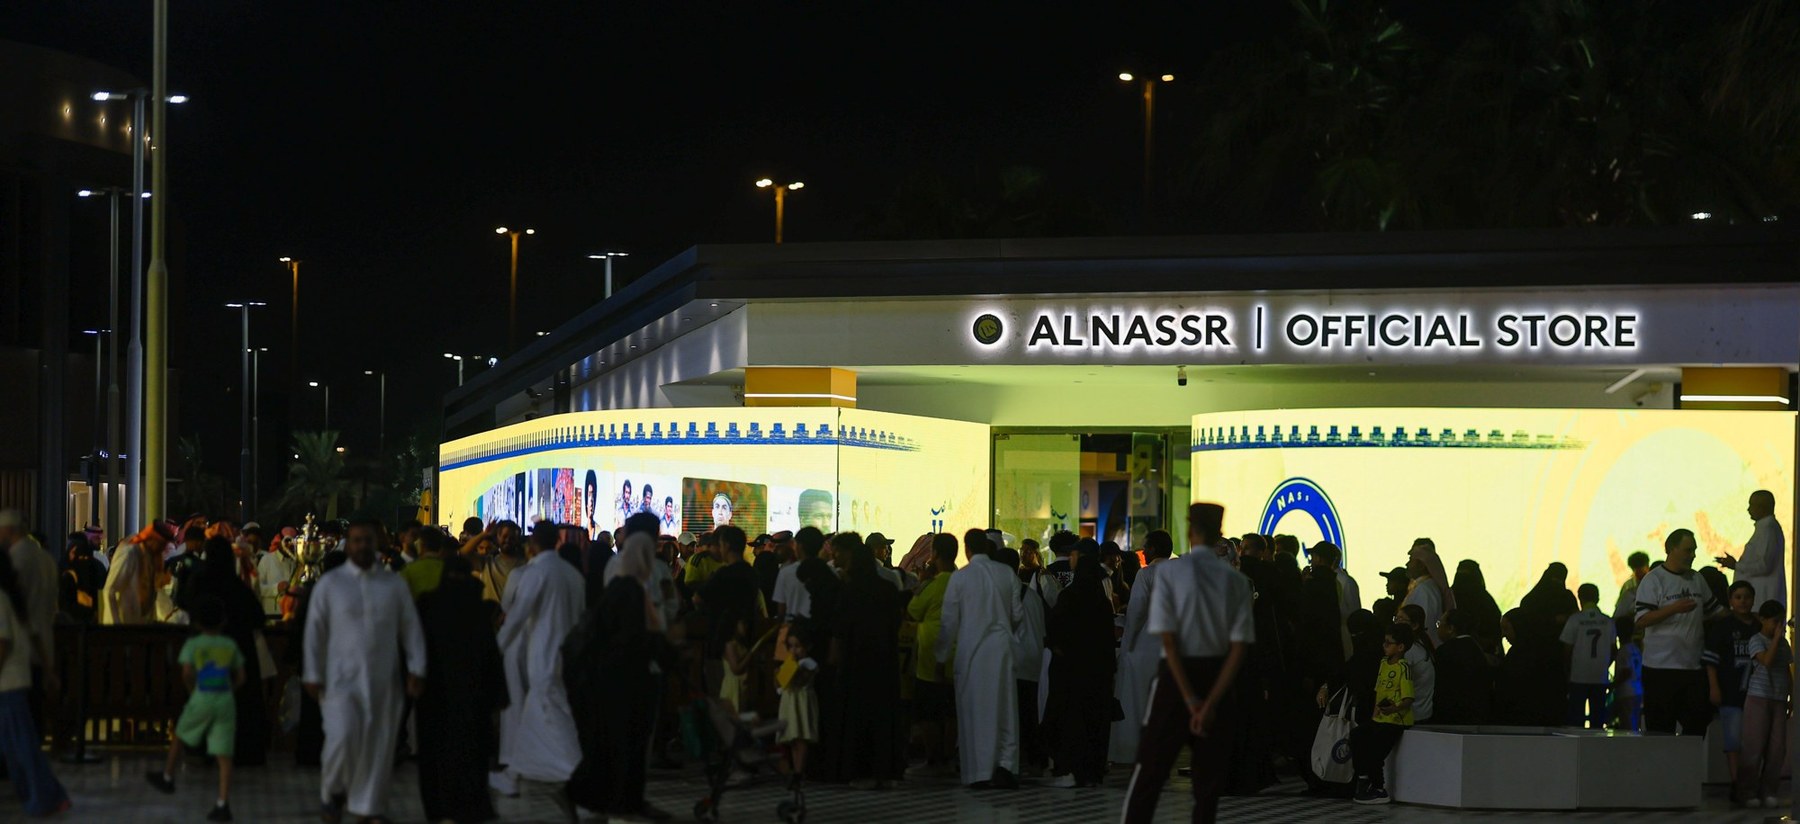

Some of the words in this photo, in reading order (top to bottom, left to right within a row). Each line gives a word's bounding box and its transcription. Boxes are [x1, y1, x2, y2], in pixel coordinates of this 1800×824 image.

[1028, 314, 1231, 347] ALNASSR
[1286, 313, 1480, 348] OFFICIAL
[1496, 314, 1637, 348] STORE
[1586, 628, 1602, 658] 7
